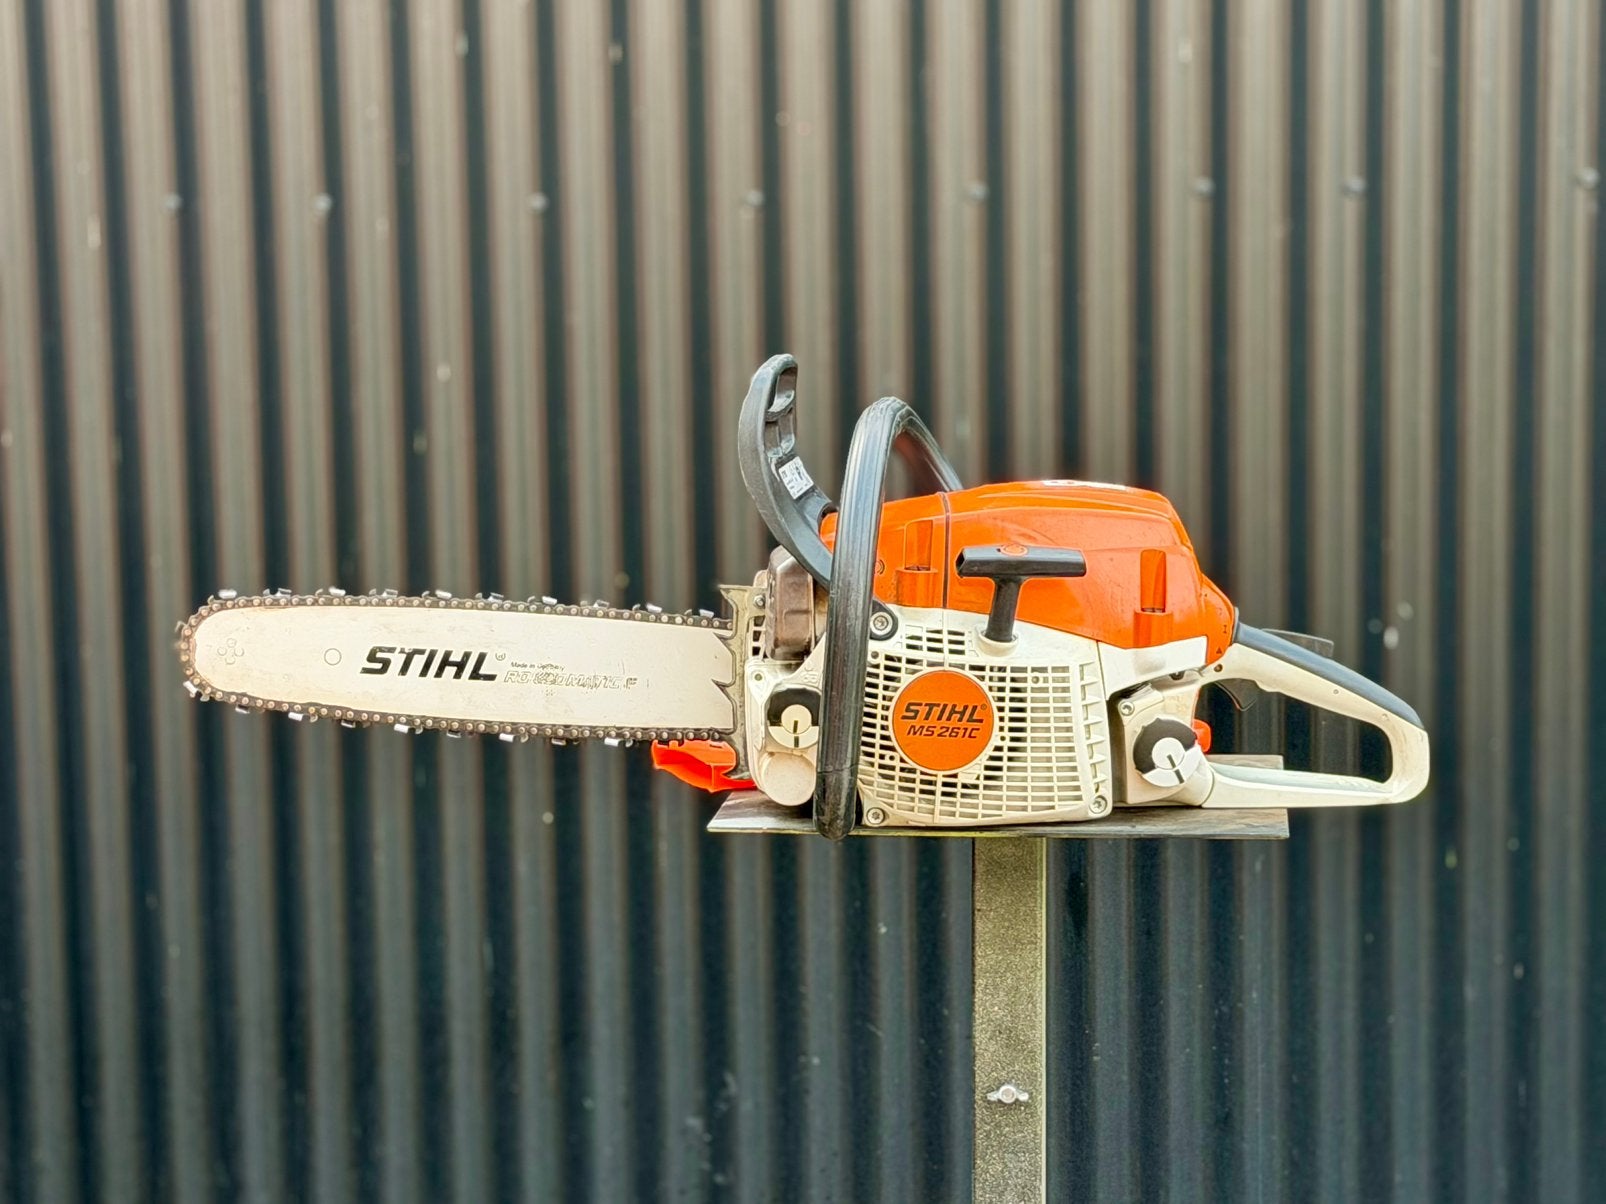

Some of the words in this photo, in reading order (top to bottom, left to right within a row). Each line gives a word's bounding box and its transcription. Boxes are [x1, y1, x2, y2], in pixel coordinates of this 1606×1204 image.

[359, 645, 498, 682] STIHL
[510, 661, 528, 669] Made
[901, 702, 984, 723] STIHL
[907, 724, 937, 737] MS
[937, 726, 980, 738] 261C
